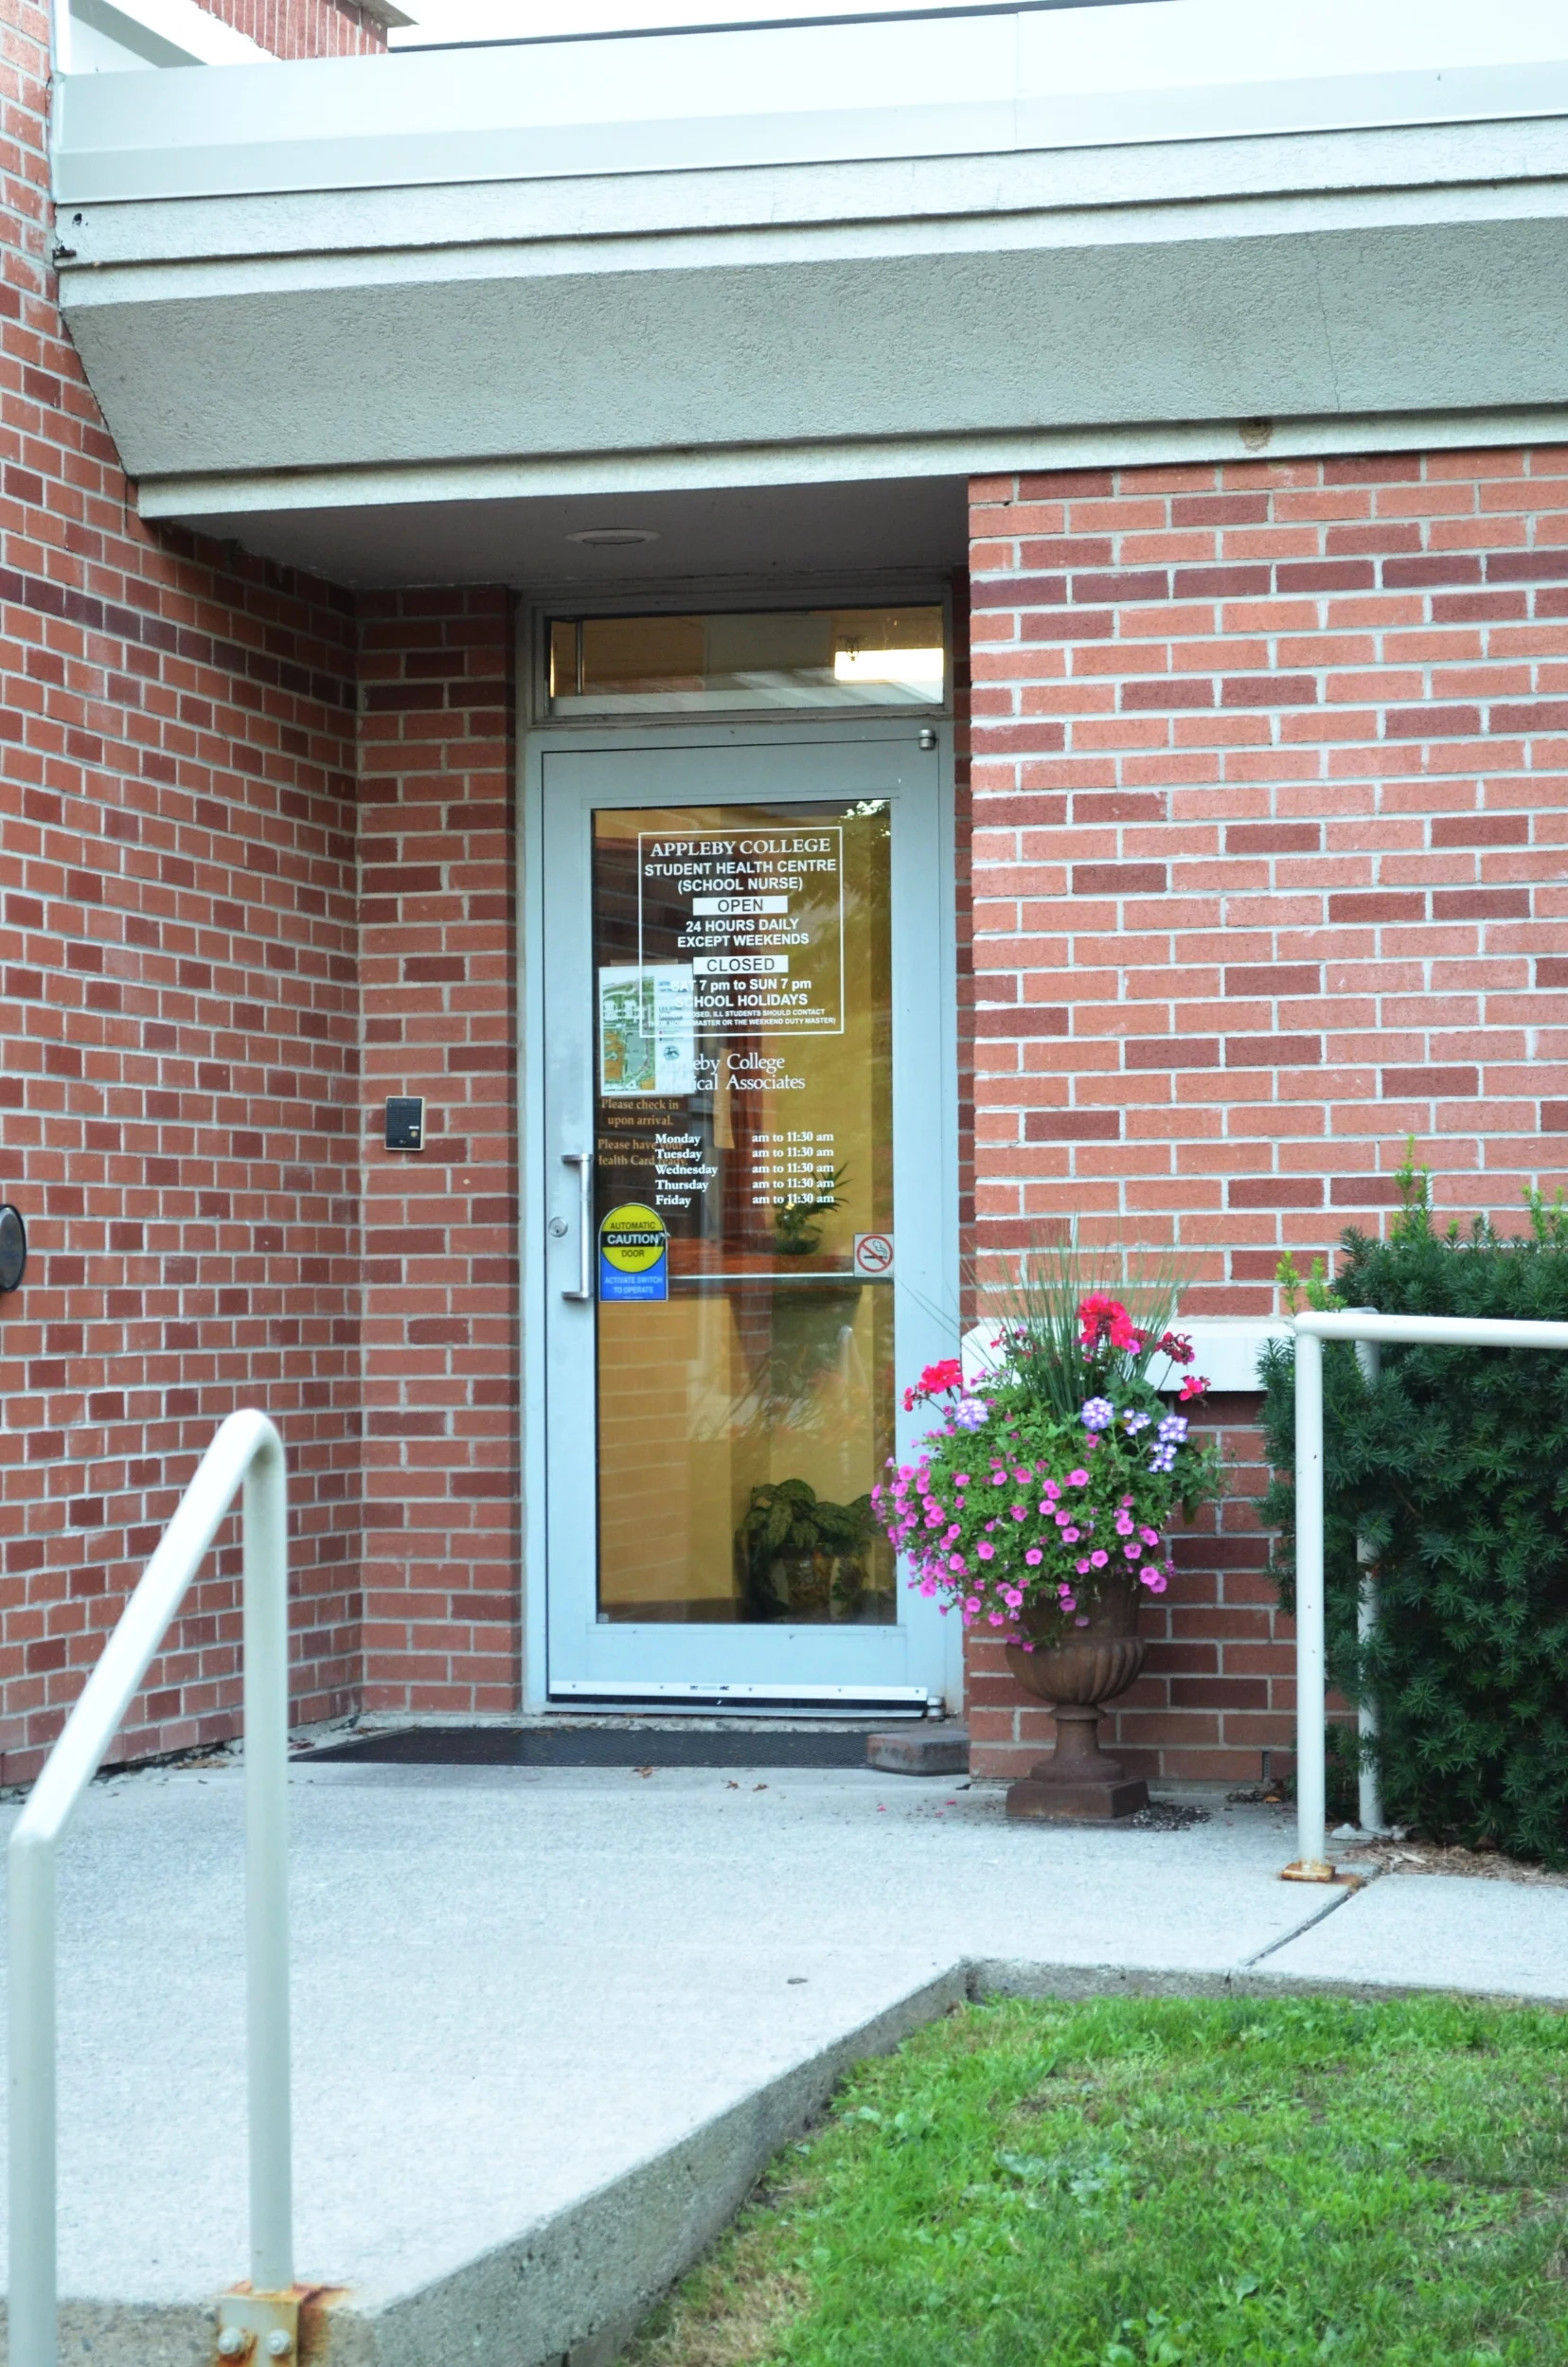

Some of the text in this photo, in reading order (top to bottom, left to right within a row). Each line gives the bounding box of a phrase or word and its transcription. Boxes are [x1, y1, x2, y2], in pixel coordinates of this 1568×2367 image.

[650, 838, 831, 857] APPLEBY COLLEGE
[645, 859, 836, 876] STUDENT HEALTH CENTRE
[678, 877, 803, 895] (SCHOOL NURSE)
[718, 899, 763, 913] OPEN
[686, 918, 799, 933] 24 HOURS DAILY
[677, 934, 810, 948] EXCEPT WEEKENDS
[706, 958, 775, 972] CLOSED
[671, 980, 696, 991] SAT
[699, 980, 707, 990] 7
[710, 980, 730, 993] pm
[733, 980, 746, 990] to
[750, 979, 777, 990] SUN
[781, 978, 789, 989] 7
[792, 980, 811, 991] pm
[674, 994, 808, 1008] SCHOOL HOLIDAYS
[725, 1009, 761, 1018] STUDENTS
[727, 1052, 785, 1074] College
[725, 1074, 806, 1091] Associates
[601, 1098, 679, 1110] Please check in
[608, 1115, 673, 1128] upon arrival.
[597, 1139, 631, 1149] Please
[633, 1139, 656, 1149] have
[655, 1133, 701, 1146] Monday
[787, 1131, 813, 1142] 11:30
[816, 1133, 834, 1142] am
[631, 1155, 655, 1166] Card
[654, 1148, 703, 1162] Tuesday
[787, 1147, 813, 1157] 11:30
[816, 1148, 834, 1157] am
[655, 1165, 718, 1177] Wednesday
[787, 1163, 813, 1173] 11:30
[816, 1165, 834, 1173] am
[655, 1180, 709, 1192] Thursday
[787, 1178, 813, 1188] 11:30
[816, 1180, 834, 1188] am
[655, 1195, 691, 1208] Friday
[787, 1193, 813, 1203] 11:30
[816, 1195, 834, 1203] am
[610, 1221, 655, 1230] AUTOMATIC
[607, 1234, 659, 1244] CAUTION
